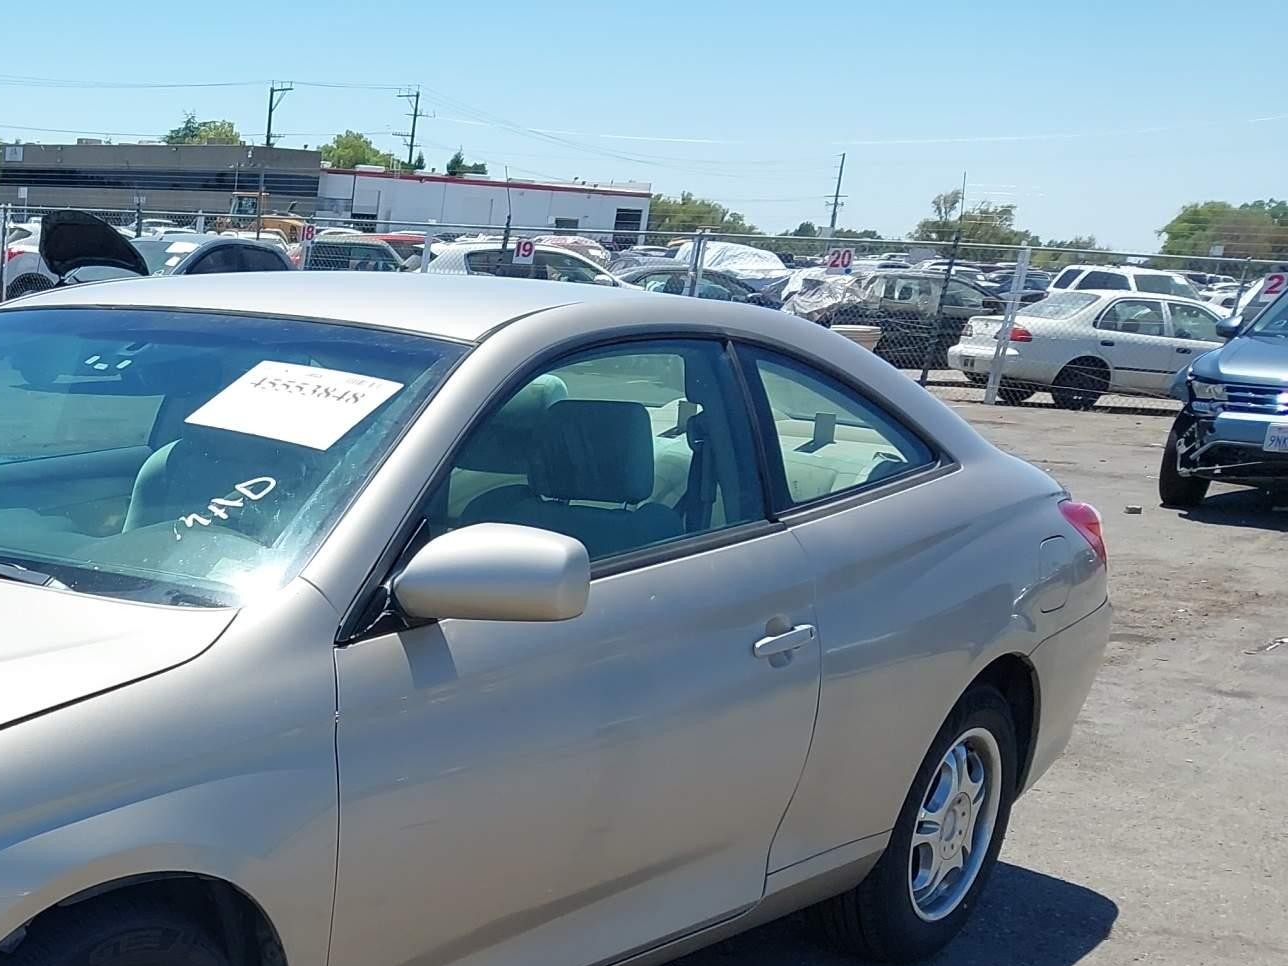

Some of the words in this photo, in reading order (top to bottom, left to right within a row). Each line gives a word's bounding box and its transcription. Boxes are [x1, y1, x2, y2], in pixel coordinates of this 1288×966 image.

[302, 225, 314, 240] 18
[515, 241, 533, 258] 19
[829, 249, 851, 268] 20
[250, 377, 366, 404] 45553848
